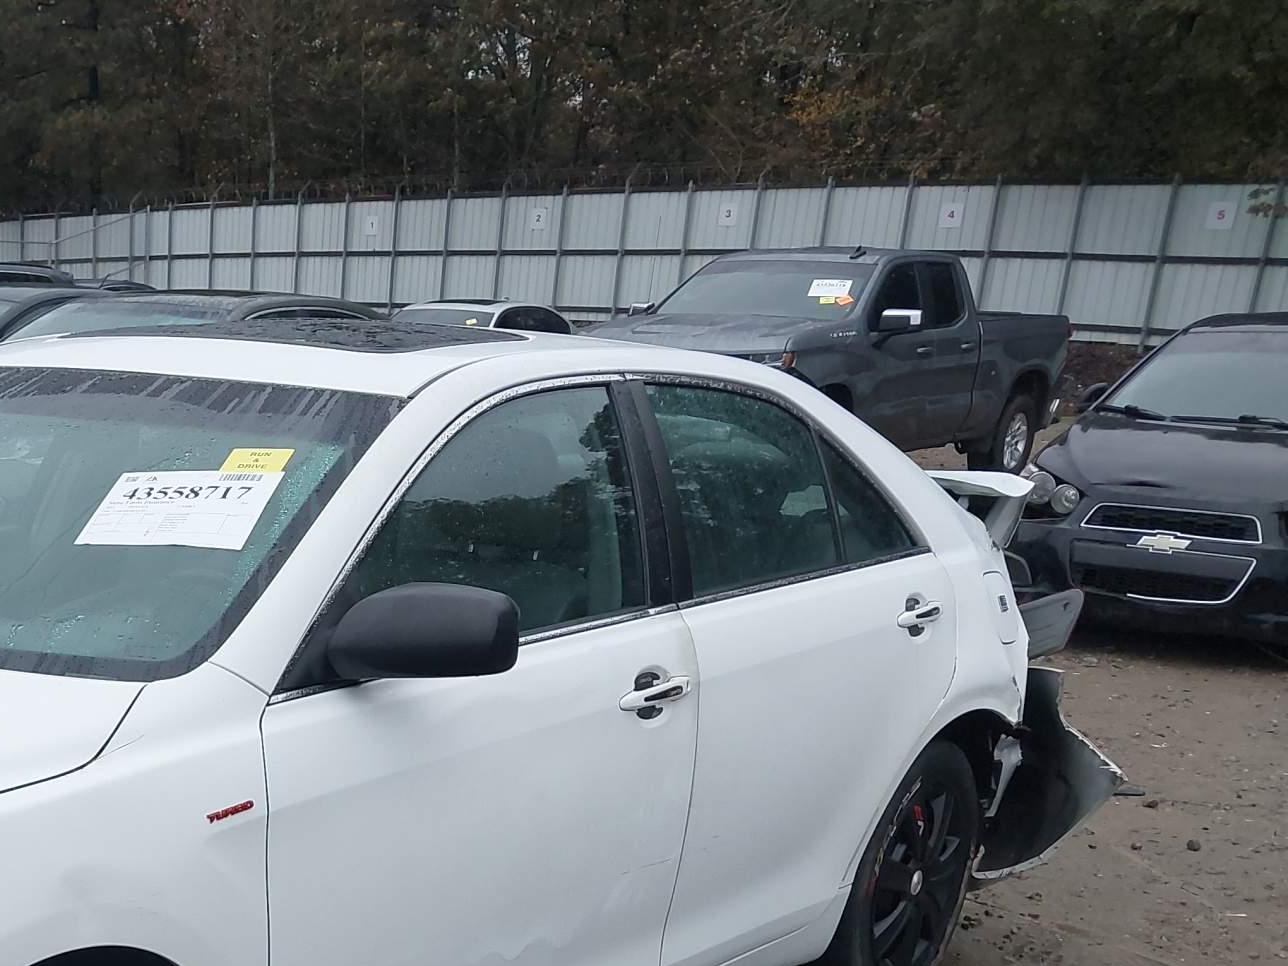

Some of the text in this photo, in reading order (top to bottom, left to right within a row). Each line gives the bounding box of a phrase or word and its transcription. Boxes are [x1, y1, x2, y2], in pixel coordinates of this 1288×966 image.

[725, 209, 732, 218] 3
[947, 210, 955, 219] 4
[1216, 209, 1225, 221] 5
[535, 214, 542, 223] 2
[123, 486, 254, 500] 43558717
